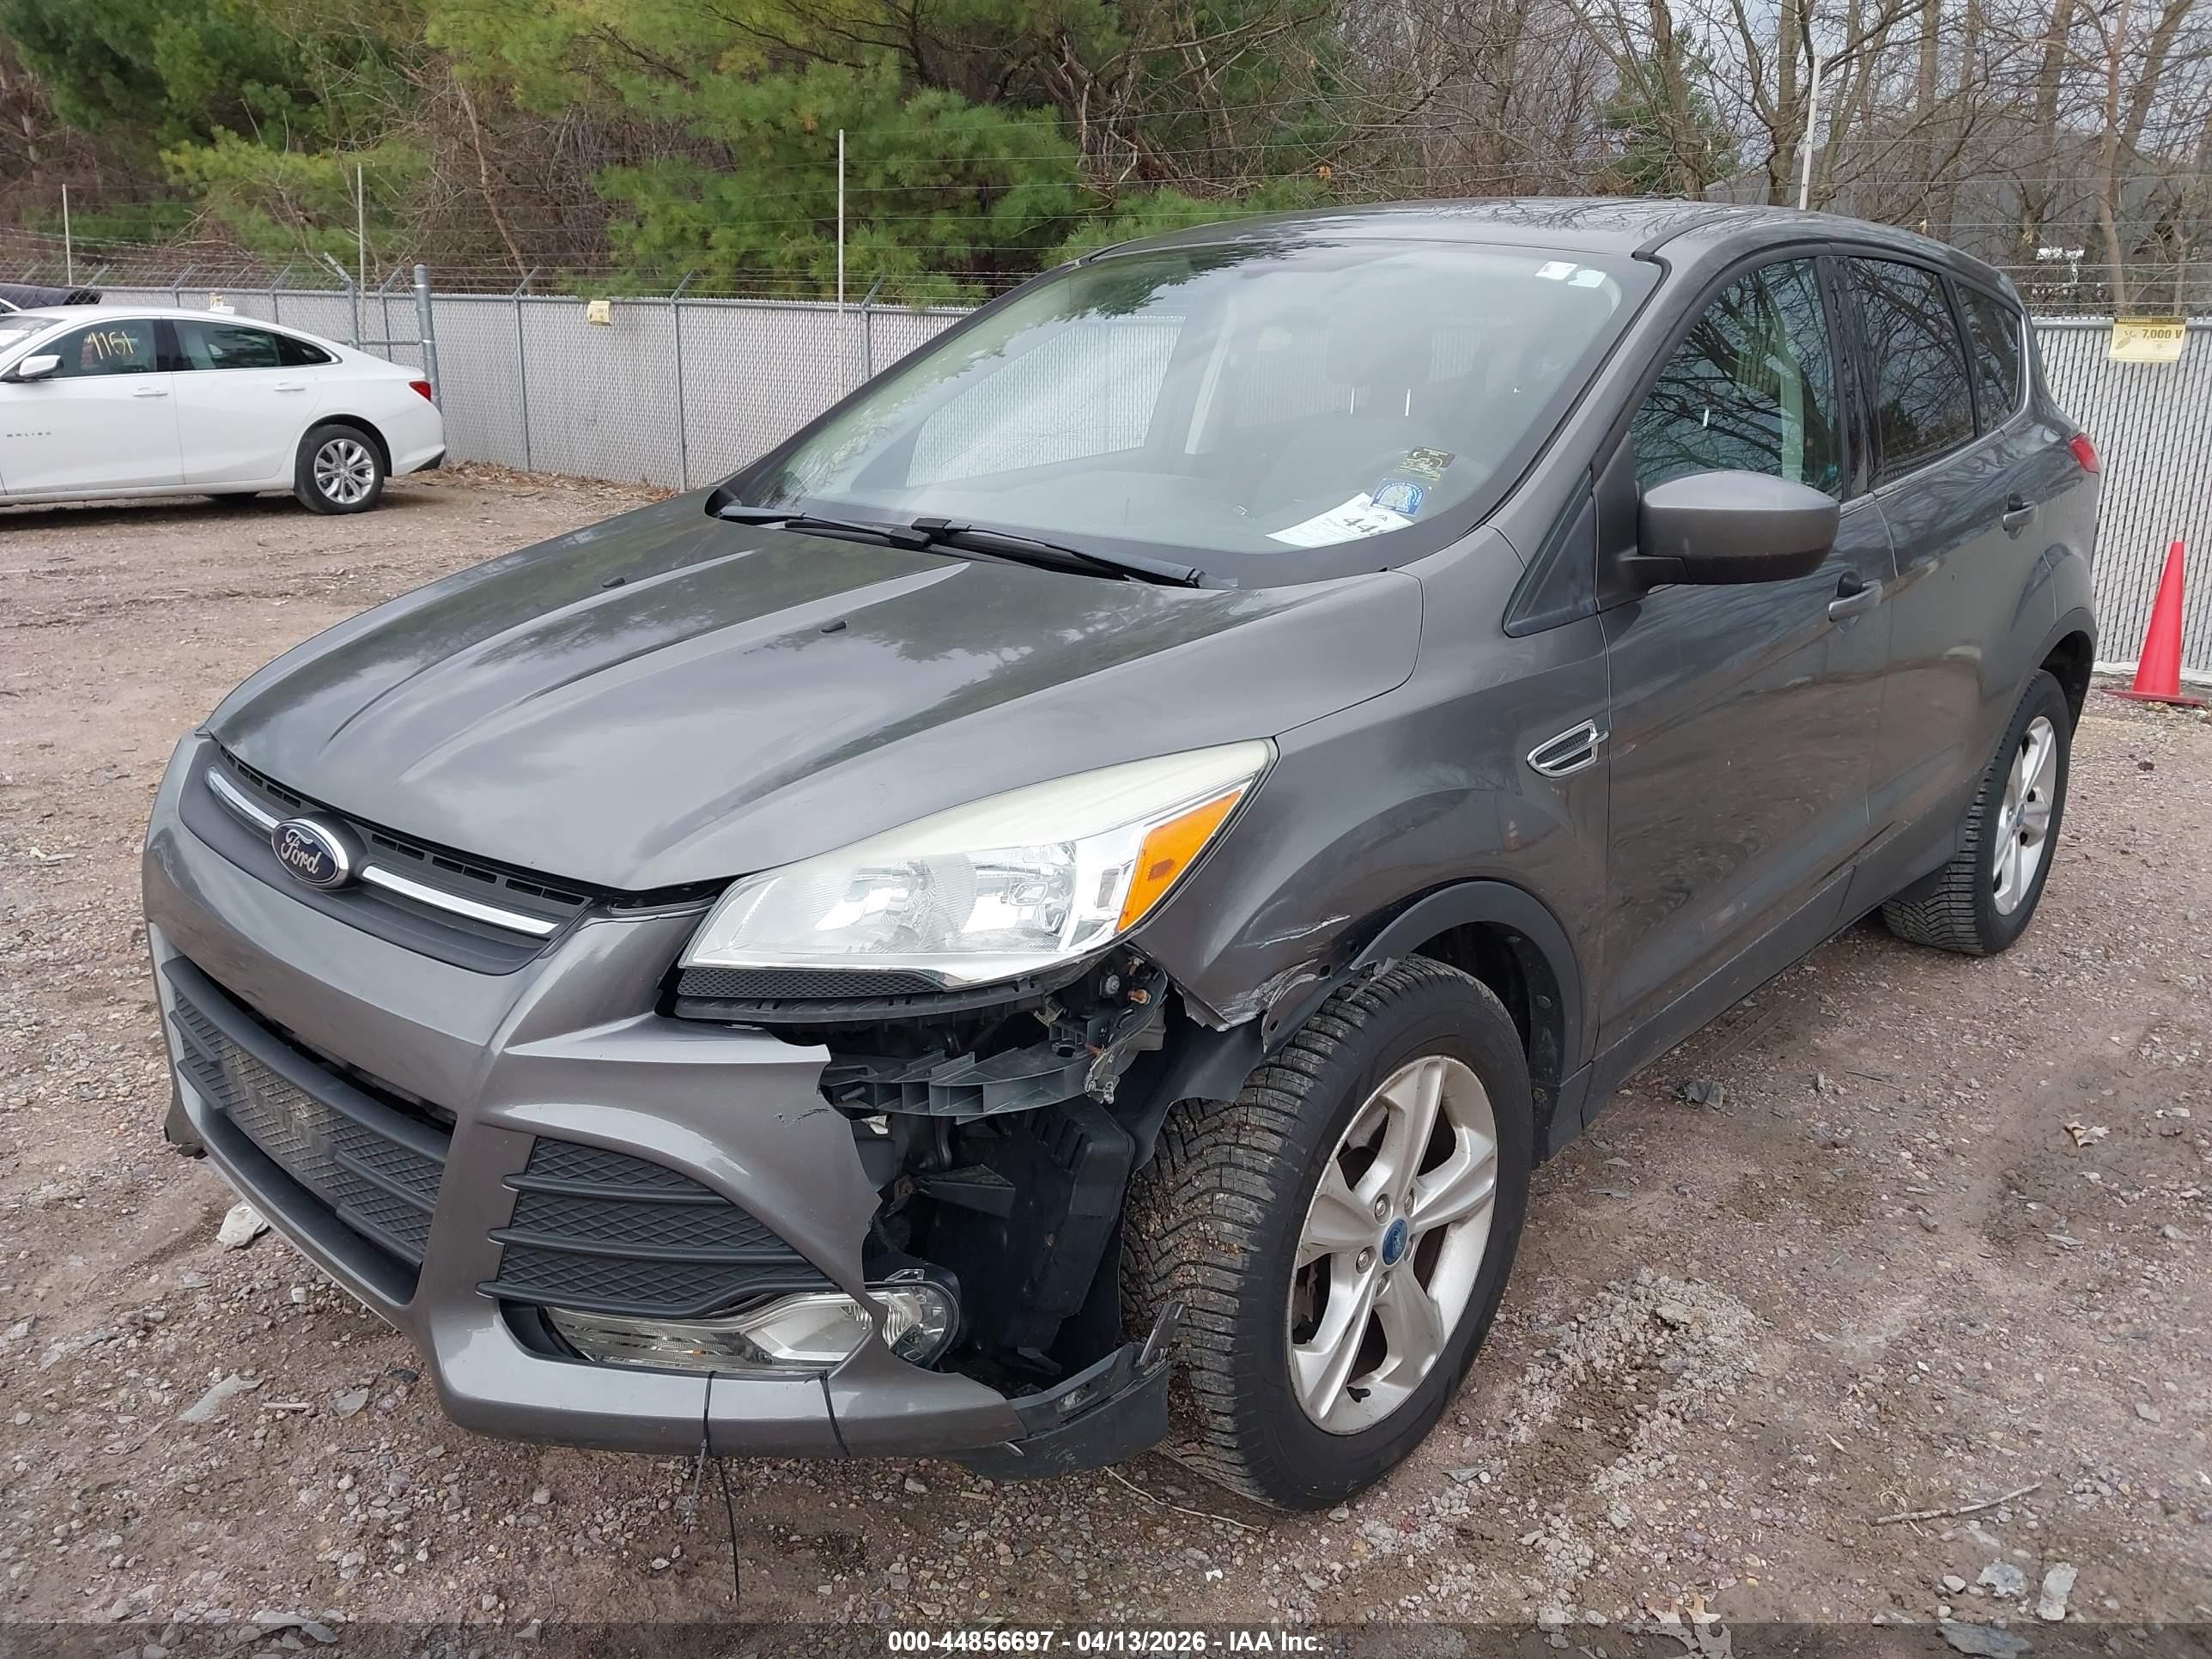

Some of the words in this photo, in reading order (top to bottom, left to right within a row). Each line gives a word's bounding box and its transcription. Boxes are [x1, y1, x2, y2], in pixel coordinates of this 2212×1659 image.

[2142, 329, 2172, 340] 7,000
[2175, 329, 2184, 339] V
[280, 829, 322, 875] Ford
